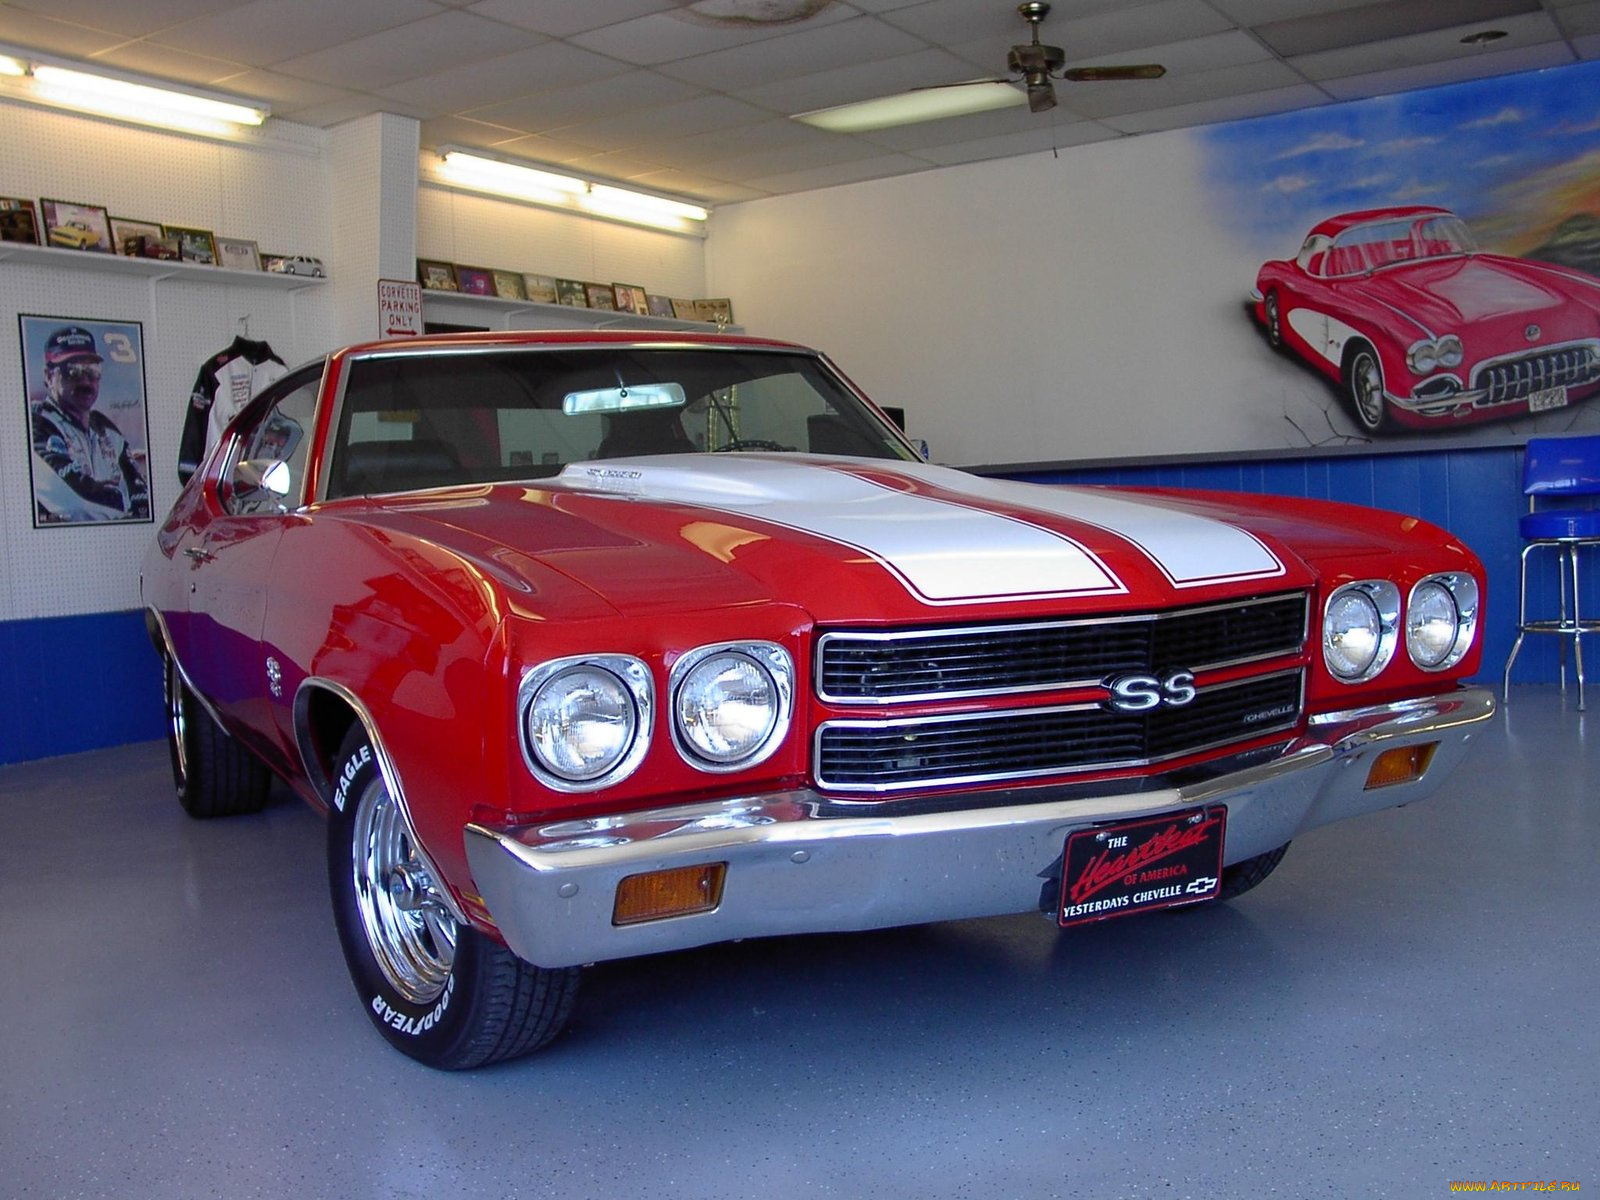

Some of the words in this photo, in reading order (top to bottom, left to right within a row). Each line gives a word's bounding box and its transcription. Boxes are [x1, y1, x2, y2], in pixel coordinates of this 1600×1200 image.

[381, 285, 418, 300] CORVETTE
[381, 300, 419, 314] PARKING
[389, 314, 413, 326] ONLY
[103, 333, 137, 363] 3
[1115, 673, 1196, 710] SS
[1246, 704, 1294, 721] CHEVELLE
[334, 745, 371, 812] EAGLE
[1108, 836, 1128, 849] THE
[1070, 819, 1219, 902] Heartbeat
[1123, 873, 1137, 886] OF
[1139, 864, 1187, 883] AMERICA
[1063, 895, 1129, 918] YESTERDAYS
[1133, 885, 1182, 904] CHEVELLE
[372, 974, 455, 1035] GOODYEAR
